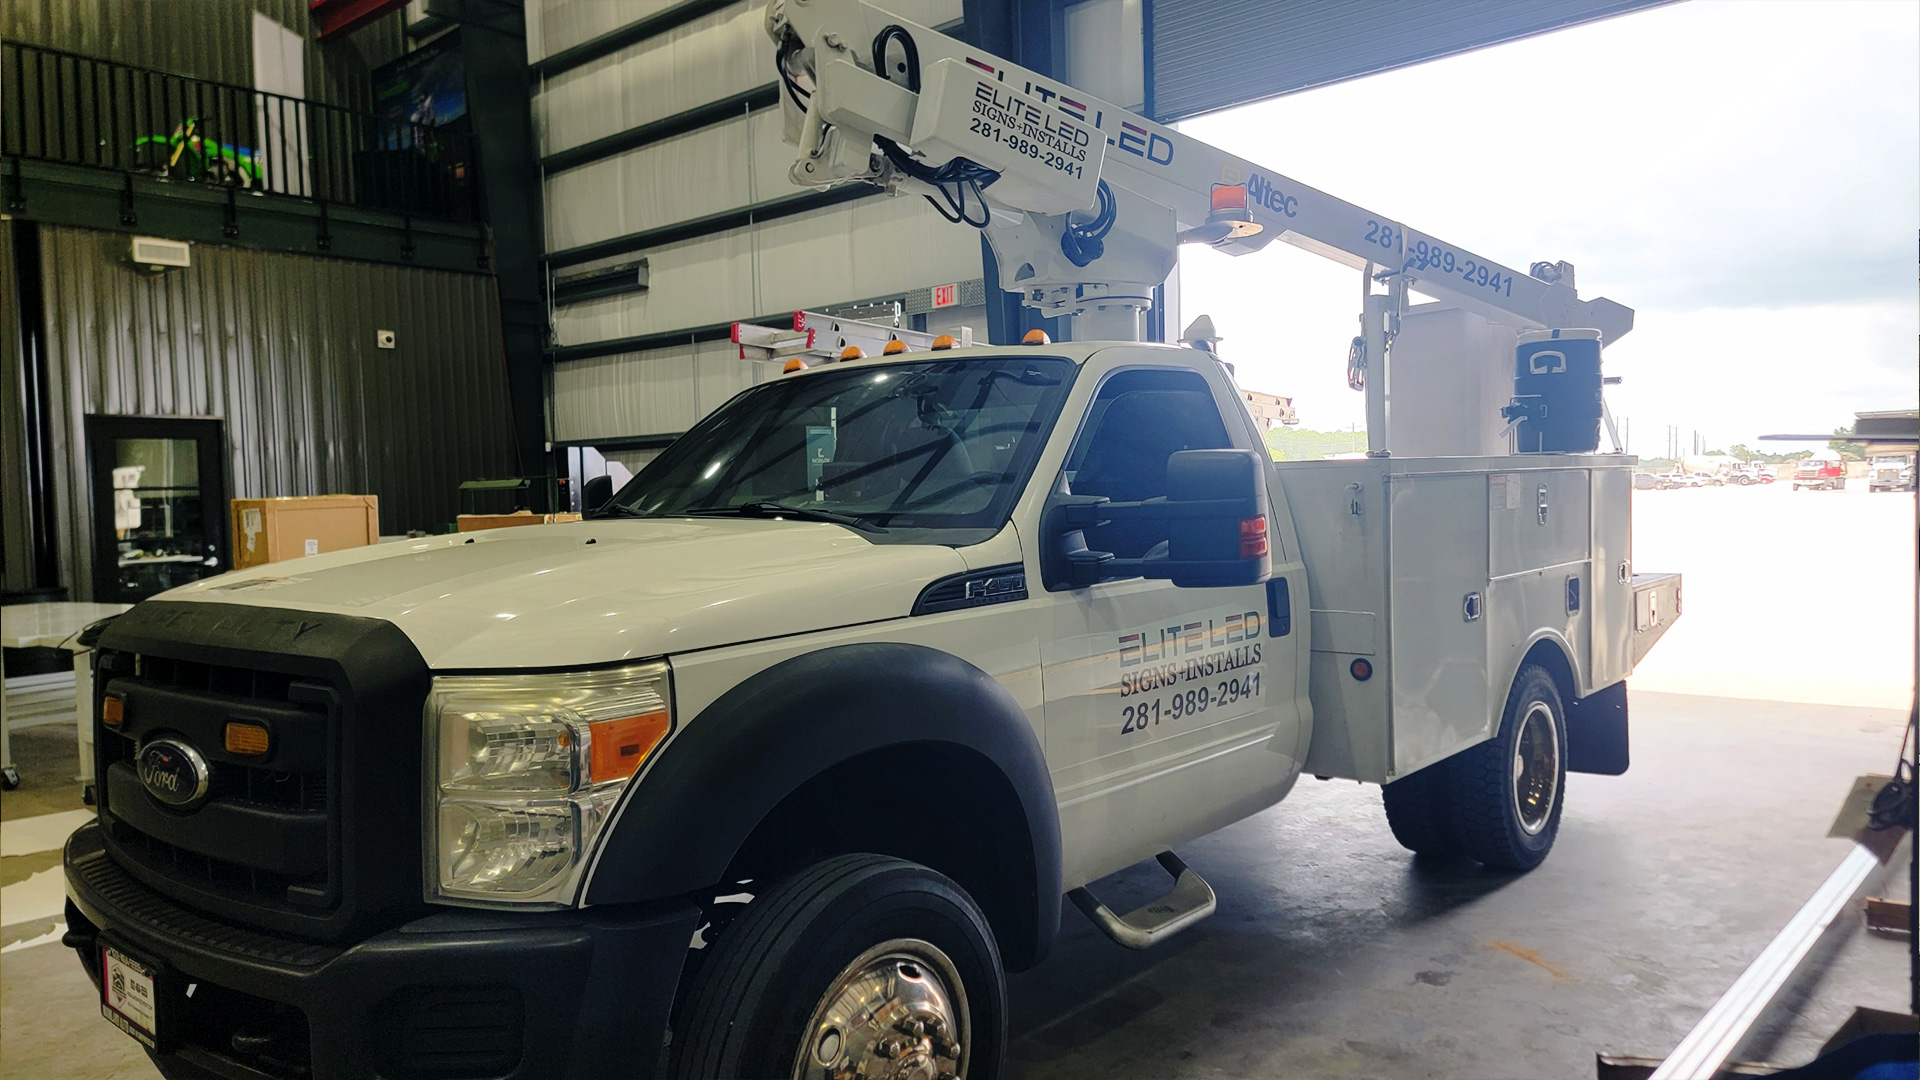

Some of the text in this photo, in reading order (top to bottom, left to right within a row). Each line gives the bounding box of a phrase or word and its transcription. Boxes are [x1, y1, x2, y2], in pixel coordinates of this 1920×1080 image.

[972, 99, 1087, 162] SIGNS+INSTALLS
[975, 81, 1042, 126] ELITE
[1044, 114, 1089, 147] LED
[969, 117, 1083, 180] 281-989-2941
[1247, 172, 1299, 218] Altec
[1364, 219, 1513, 297] 281-989-2941
[936, 285, 954, 306] EXIT
[1118, 610, 1261, 668] ELITE LED
[1120, 642, 1262, 698] SIGNS+INSTALLS
[1120, 672, 1261, 735] 281-989-2941
[144, 749, 181, 793] Ford
